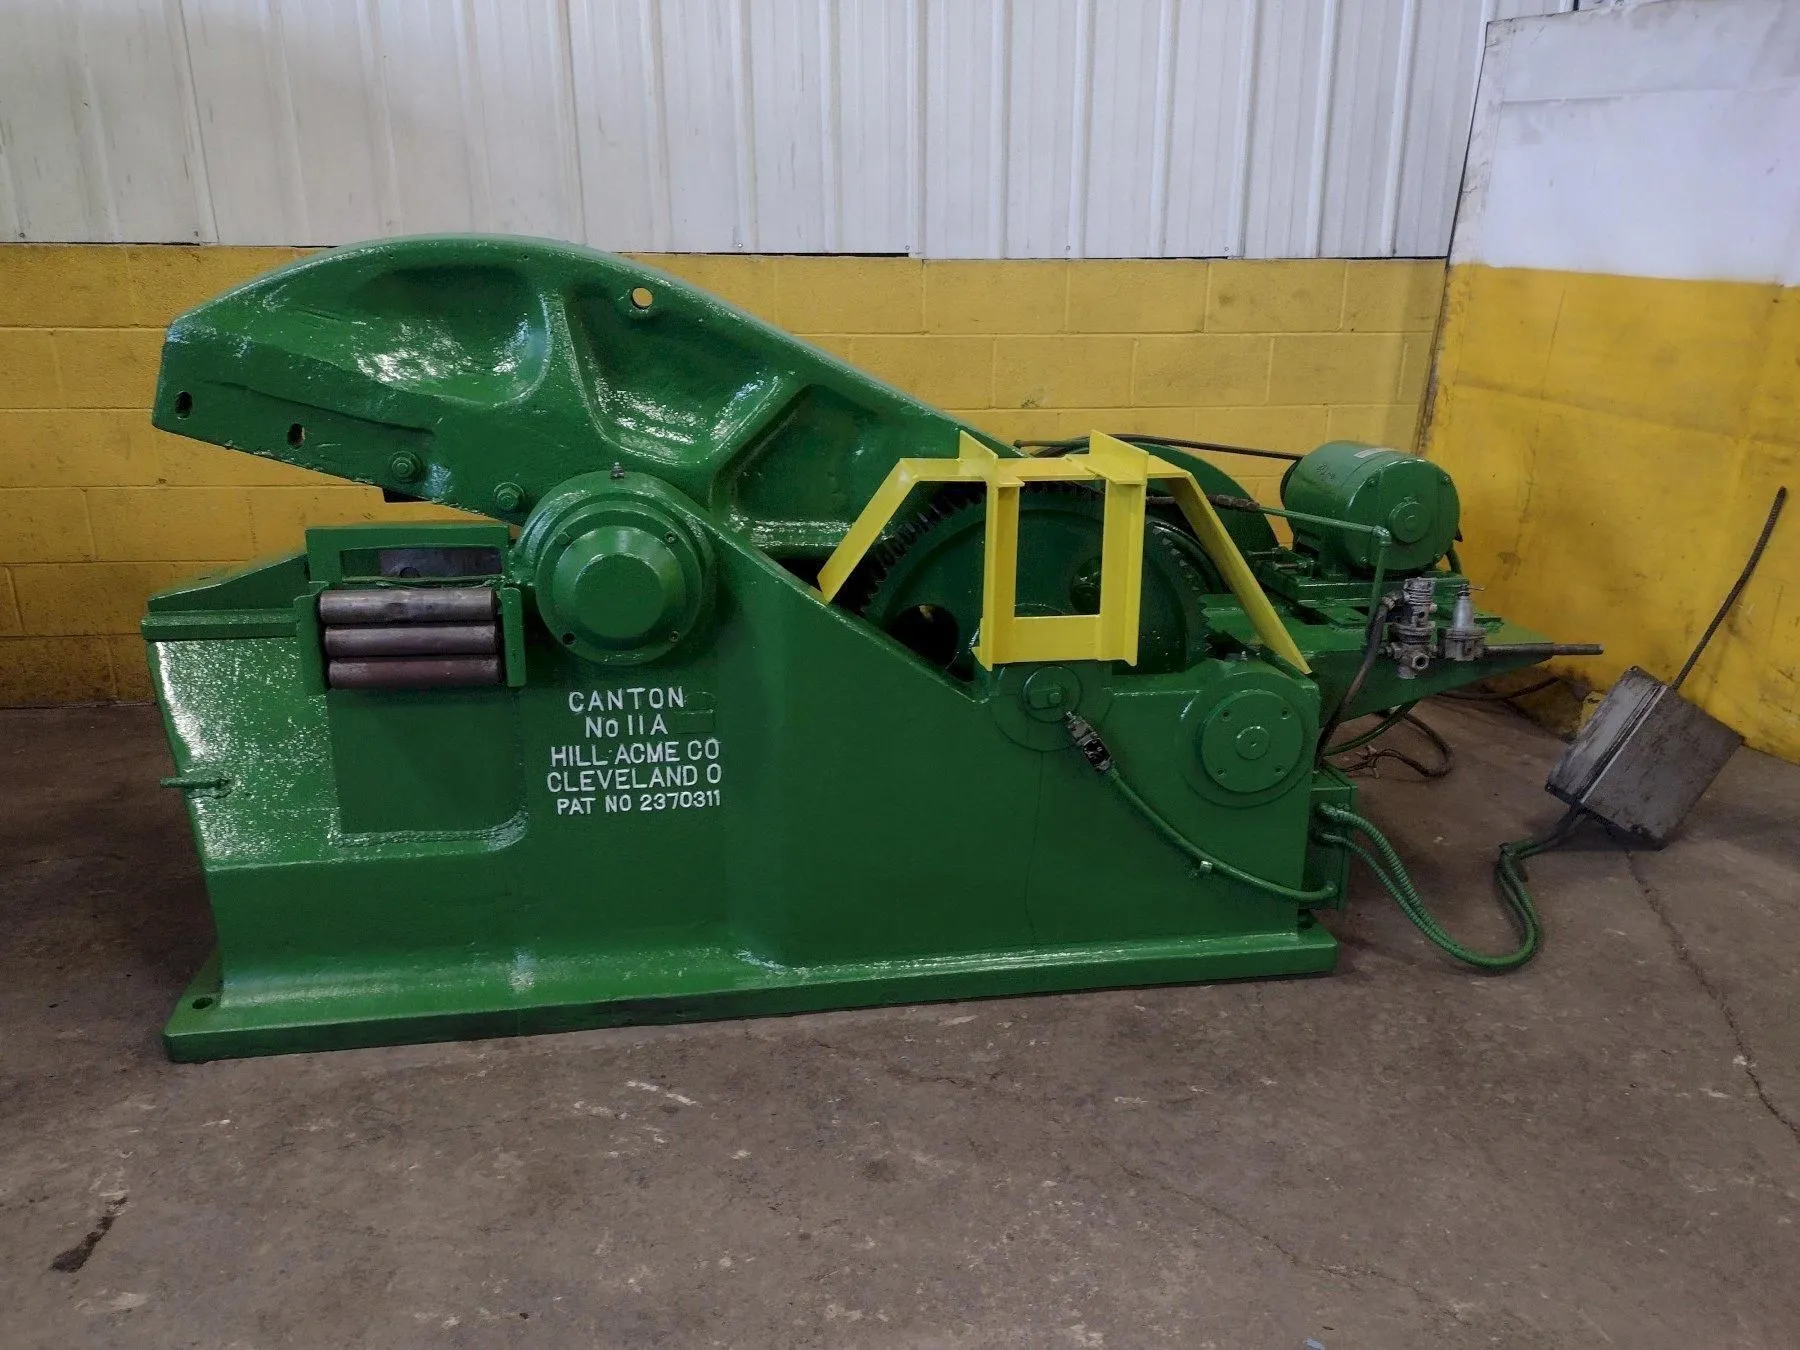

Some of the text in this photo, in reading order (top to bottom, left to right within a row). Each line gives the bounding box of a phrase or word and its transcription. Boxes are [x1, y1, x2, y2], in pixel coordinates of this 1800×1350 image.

[569, 686, 684, 712] CANTON
[551, 738, 720, 767] HILL ACME CO
[547, 764, 722, 792] CLEVELAND O
[557, 789, 721, 815] PAT NO 2370311
